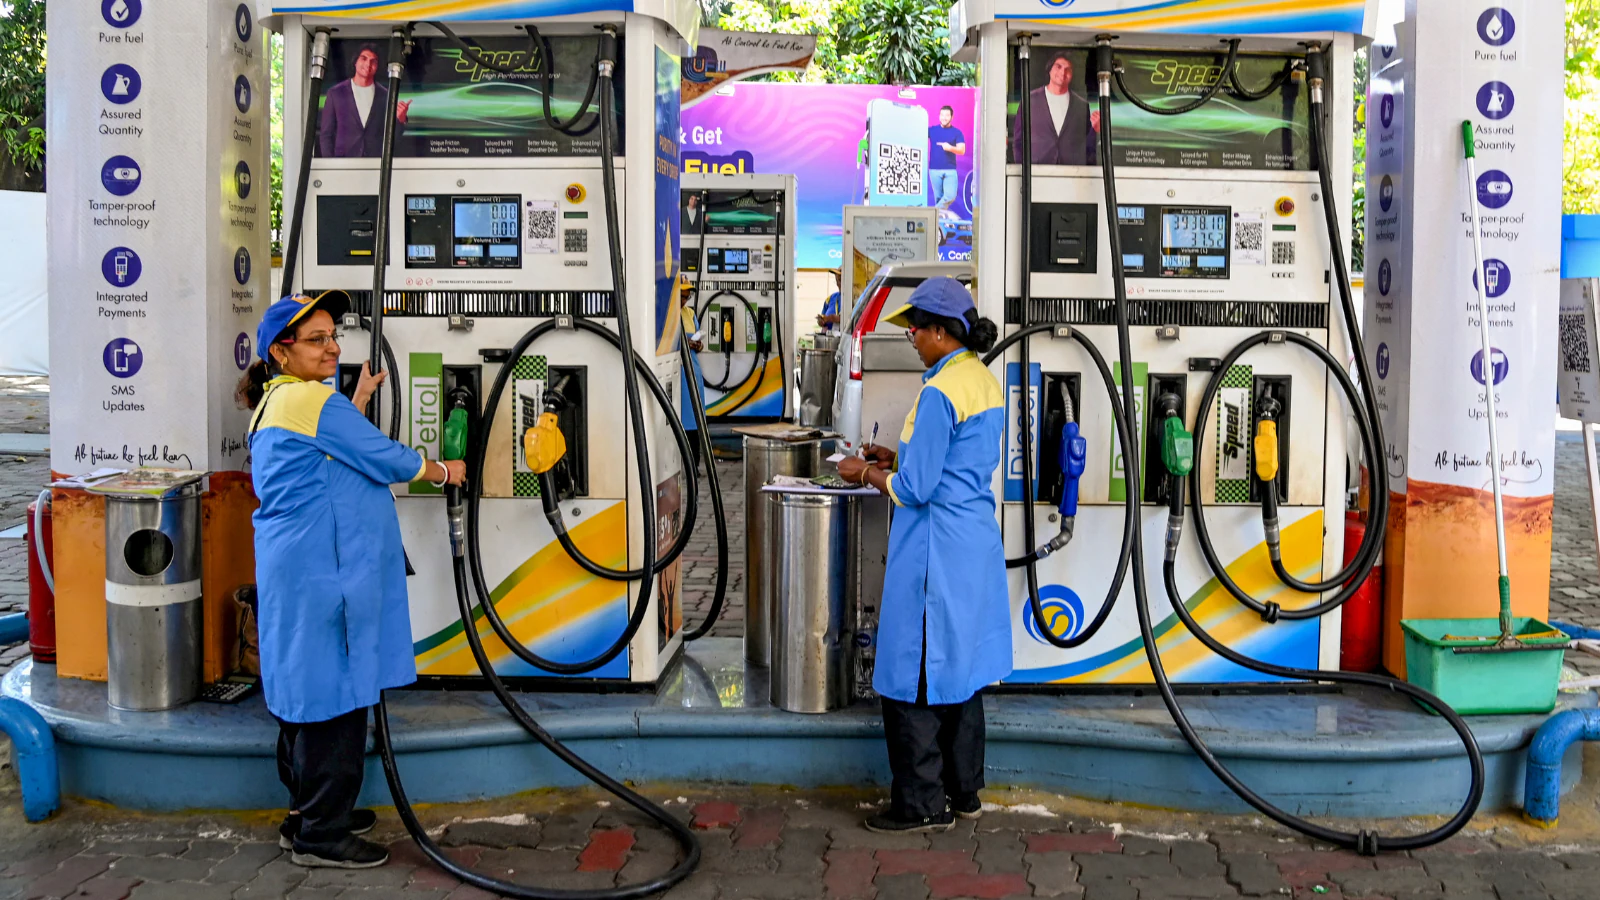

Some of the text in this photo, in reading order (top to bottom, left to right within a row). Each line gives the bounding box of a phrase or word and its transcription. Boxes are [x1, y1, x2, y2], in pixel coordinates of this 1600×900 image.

[99, 32, 143, 43] Pure fuel
[1474, 50, 1517, 61] Pure fuel
[100, 109, 141, 119] Assured
[98, 125, 143, 138] Quantity
[692, 125, 723, 145] Get
[1475, 125, 1514, 135] Assured
[1473, 140, 1515, 152] Quantity
[685, 158, 745, 174] Fuel
[88, 200, 156, 216] Tamper-proof
[93, 217, 150, 229] technology
[1460, 212, 1525, 226] Taper-proof
[1466, 227, 1519, 242] tehnology
[96, 291, 148, 305] Integrated
[98, 308, 146, 320] Payments
[1466, 302, 1516, 315] Intgrated
[1468, 316, 1513, 327] Paments
[111, 386, 135, 396] SMS
[1478, 393, 1500, 403] SS
[103, 401, 145, 413] Updates
[1468, 408, 1508, 420] Uptes
[1223, 402, 1244, 460] Speed
[75, 443, 87, 463] Ab
[91, 446, 118, 466] future
[123, 444, 134, 463] ko
[139, 444, 158, 466] feel
[1435, 450, 1448, 470] Ab
[1453, 453, 1481, 472] future
[1501, 451, 1517, 472] feel
